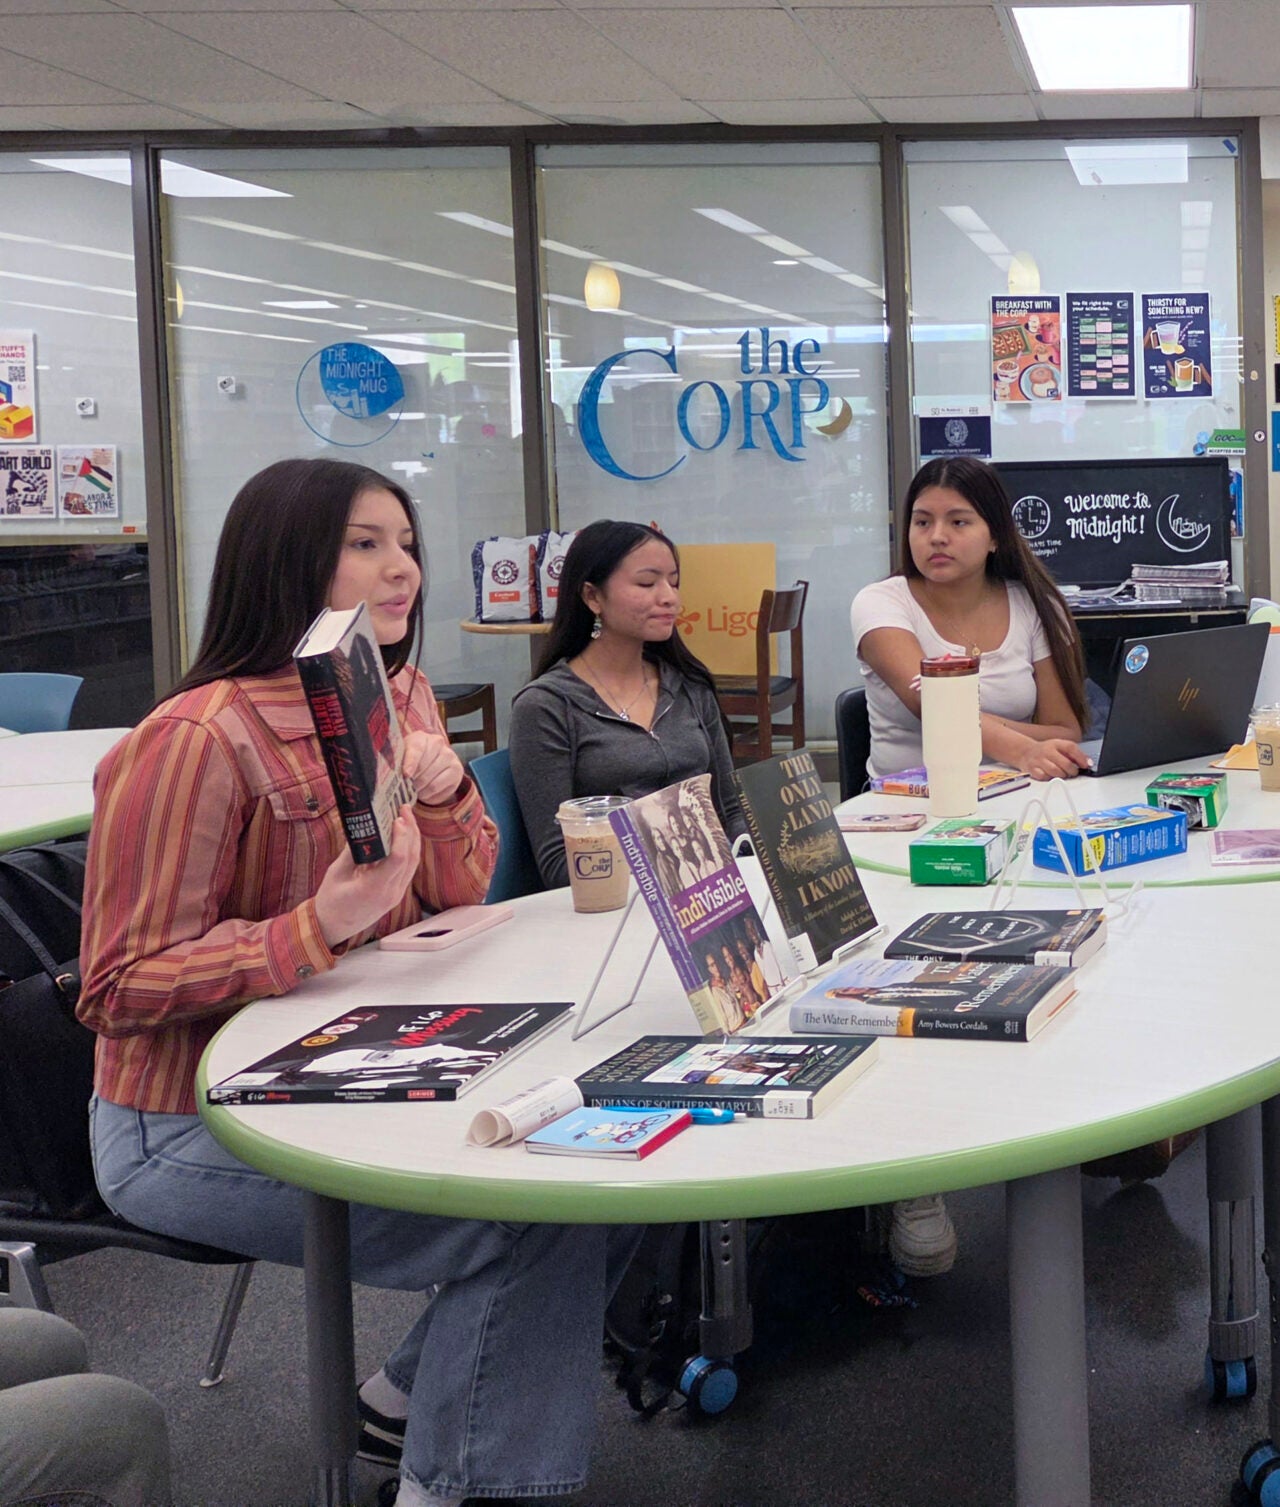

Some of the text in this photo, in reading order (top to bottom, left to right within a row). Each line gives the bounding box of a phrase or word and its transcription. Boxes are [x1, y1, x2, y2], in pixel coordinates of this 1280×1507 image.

[995, 300, 1052, 309] BREAKFAST WITH
[1148, 298, 1187, 307] THIRSTY FOR
[1148, 306, 1204, 315] SOMETHING NEW?
[996, 309, 1027, 318] THE CORP
[327, 348, 348, 362] THE
[736, 327, 822, 376] the
[326, 361, 384, 378] MIDNIGHT
[360, 378, 387, 393] MUG
[0, 456, 51, 470] ART BUILD
[1064, 491, 1151, 513] Welcome to
[1066, 514, 1145, 544] Midnight!
[1178, 678, 1200, 711] hp
[780, 753, 815, 779] THE
[780, 775, 822, 806] ONLY
[787, 799, 832, 831] LAND
[350, 826, 376, 840] JONES
[738, 791, 751, 813] THE
[746, 812, 760, 838] ONLY
[755, 839, 770, 867] LAND
[767, 870, 783, 900] KNOW
[798, 863, 856, 908] I KNOW
[673, 873, 746, 928] indiVisible
[948, 915, 962, 924] THE
[804, 1012, 903, 1028] The Water Remembers
[918, 1020, 988, 1030] Amy Bowers Cordalis
[592, 1098, 636, 1108] INDIANS
[638, 1100, 652, 1108] OF
[653, 1100, 712, 1109] SOUTHERN
